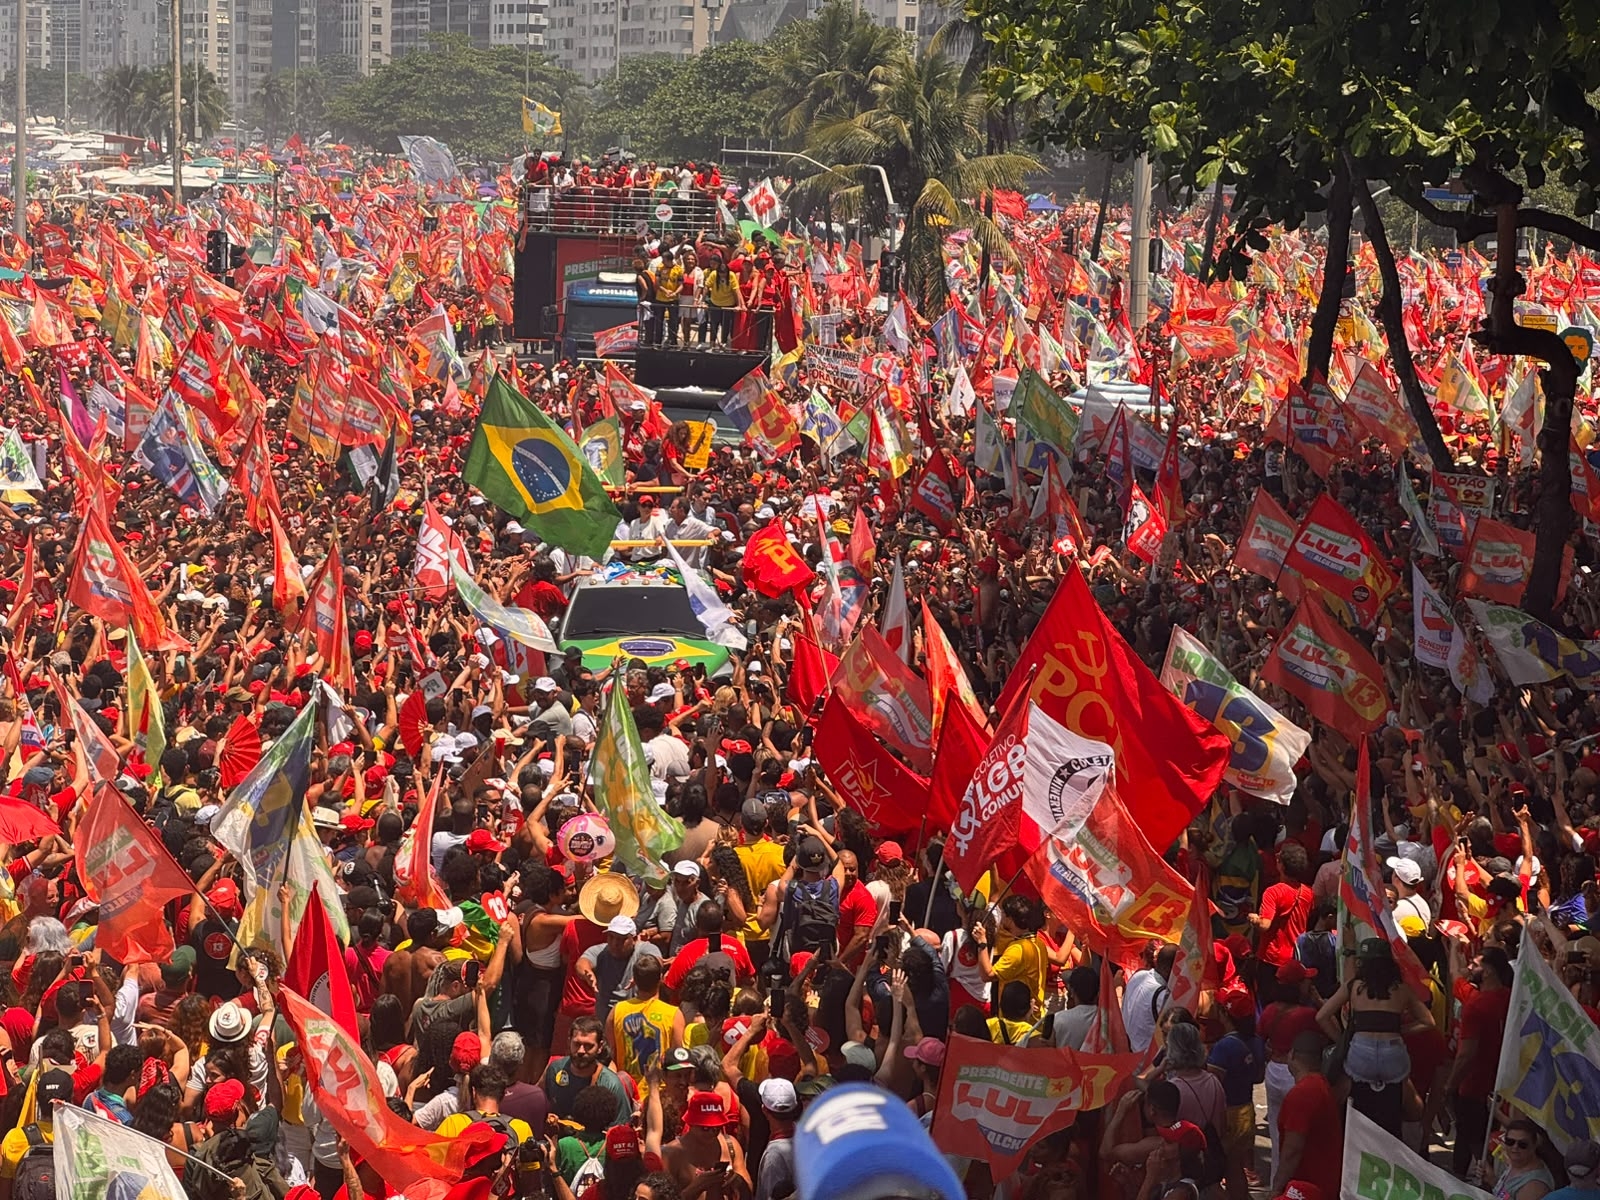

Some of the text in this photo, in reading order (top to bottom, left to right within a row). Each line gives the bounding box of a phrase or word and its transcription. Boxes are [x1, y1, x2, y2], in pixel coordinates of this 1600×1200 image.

[1353, 386, 1390, 412] LULA
[752, 393, 792, 439] 13
[1462, 488, 1484, 500] 99
[287, 515, 301, 528] 13
[996, 506, 1009, 518] 13
[1057, 539, 1073, 553] 13
[1299, 532, 1361, 567] LULA
[1417, 635, 1450, 653] BENEDIT
[1283, 637, 1347, 680] LULA
[1347, 678, 1380, 708] 13
[973, 734, 1017, 780] COLETIVO
[1070, 755, 1112, 770] COLET
[488, 896, 507, 920] 13
[1124, 885, 1187, 935] 13
[310, 975, 328, 1004] OVIMENTO
[1521, 966, 1594, 1051] BRASIL
[959, 1066, 1045, 1091] PRESIDENTE
[701, 1104, 722, 1112] LULA
